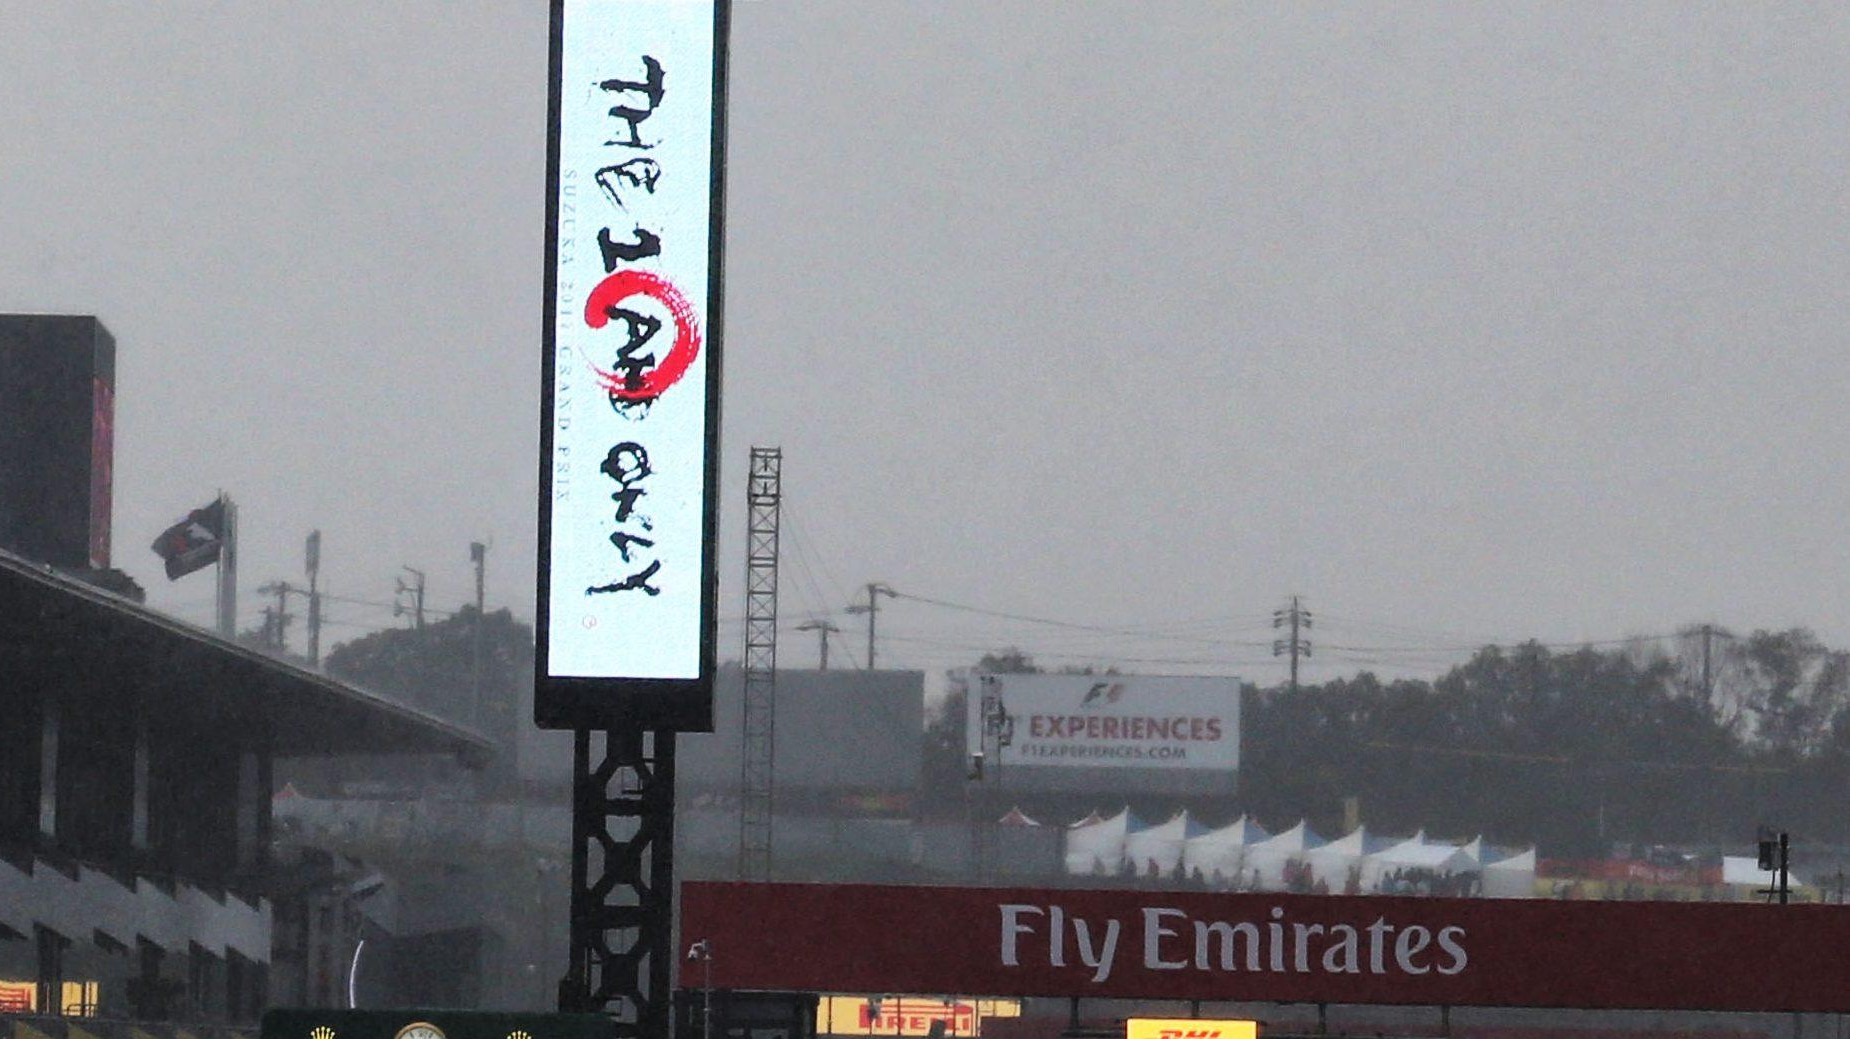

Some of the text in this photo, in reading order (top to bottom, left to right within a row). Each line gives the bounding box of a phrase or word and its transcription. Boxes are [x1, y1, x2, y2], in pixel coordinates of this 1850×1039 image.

[593, 55, 666, 213] THE
[596, 226, 662, 273] 1
[556, 168, 577, 503] SUZUKA 2017 GRAND PRIX
[584, 442, 662, 598] ONLY
[1030, 715, 1223, 742] EXPERIENCES
[999, 904, 1469, 982] Fly Emirates
